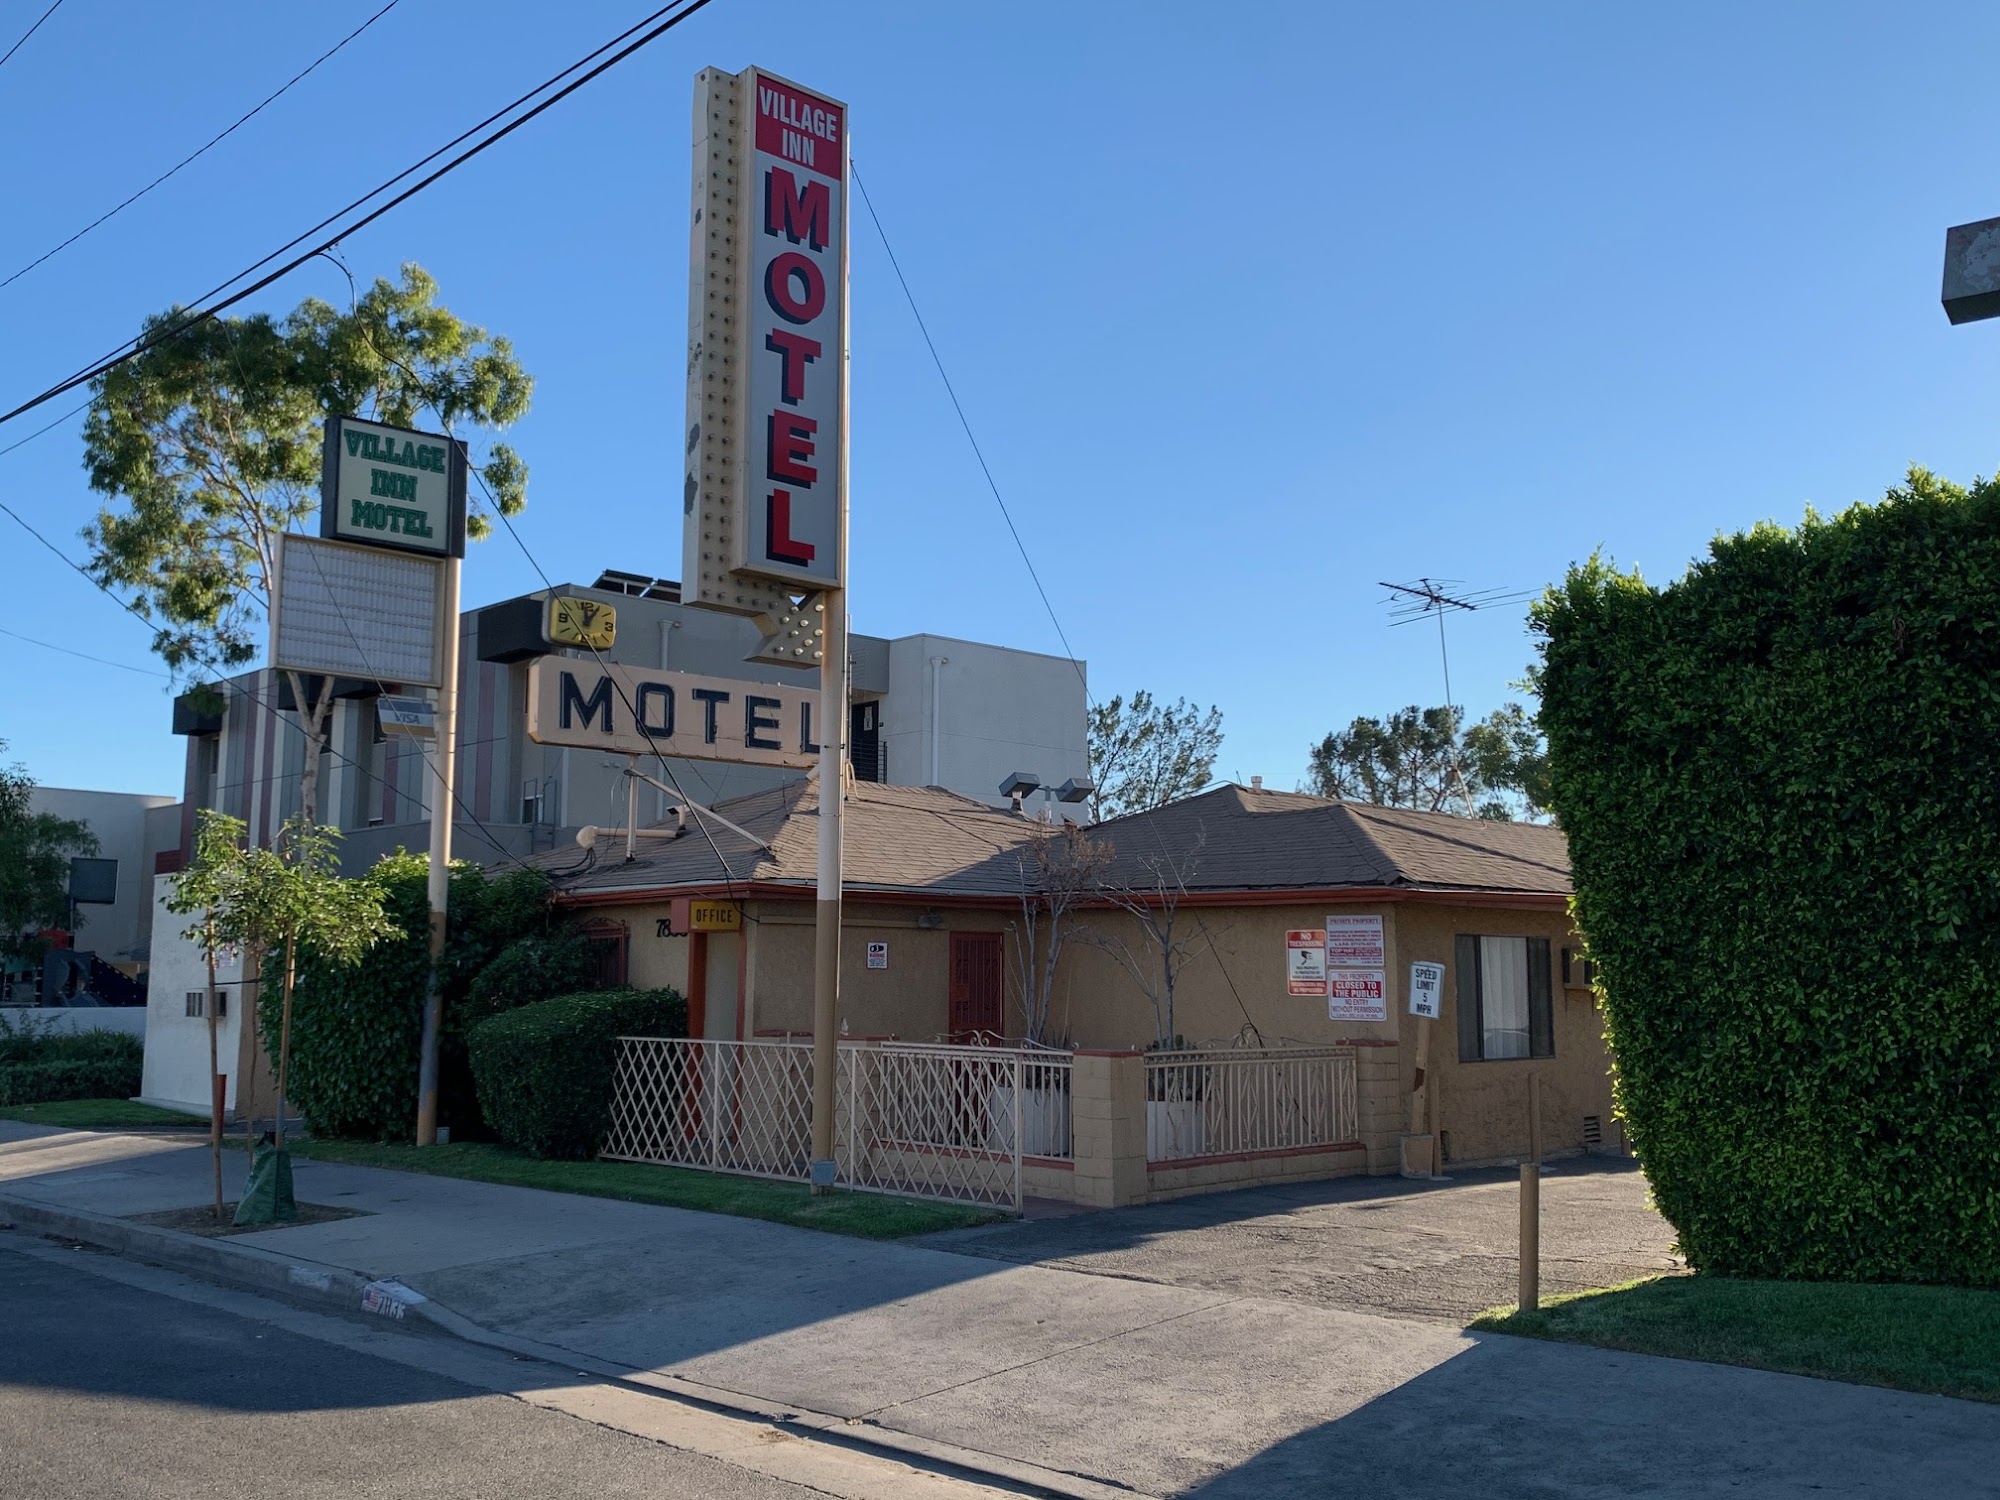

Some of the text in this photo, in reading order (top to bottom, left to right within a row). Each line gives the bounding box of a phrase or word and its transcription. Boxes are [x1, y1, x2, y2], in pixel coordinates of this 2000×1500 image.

[759, 86, 837, 143] VILLAGE
[782, 128, 815, 167] INN
[765, 166, 830, 567] MOTEL
[343, 428, 446, 474] VILLAGE
[370, 468, 418, 502] INN
[351, 499, 433, 539] MOTEL
[558, 612, 568, 623] 9
[604, 621, 614, 632] 3
[394, 711, 420, 724] VISA
[558, 670, 822, 755] MOTEL
[695, 908, 733, 923] OFFICE
[1300, 932, 1312, 941] NO
[1415, 968, 1437, 980] SPEED
[1367, 982, 1377, 990] TO
[1416, 980, 1435, 991] LIMIT
[1334, 989, 1350, 998] THE
[1351, 989, 1379, 998] PUBLIC
[1422, 992, 1428, 1003] 5
[1416, 1003, 1432, 1015] MPH
